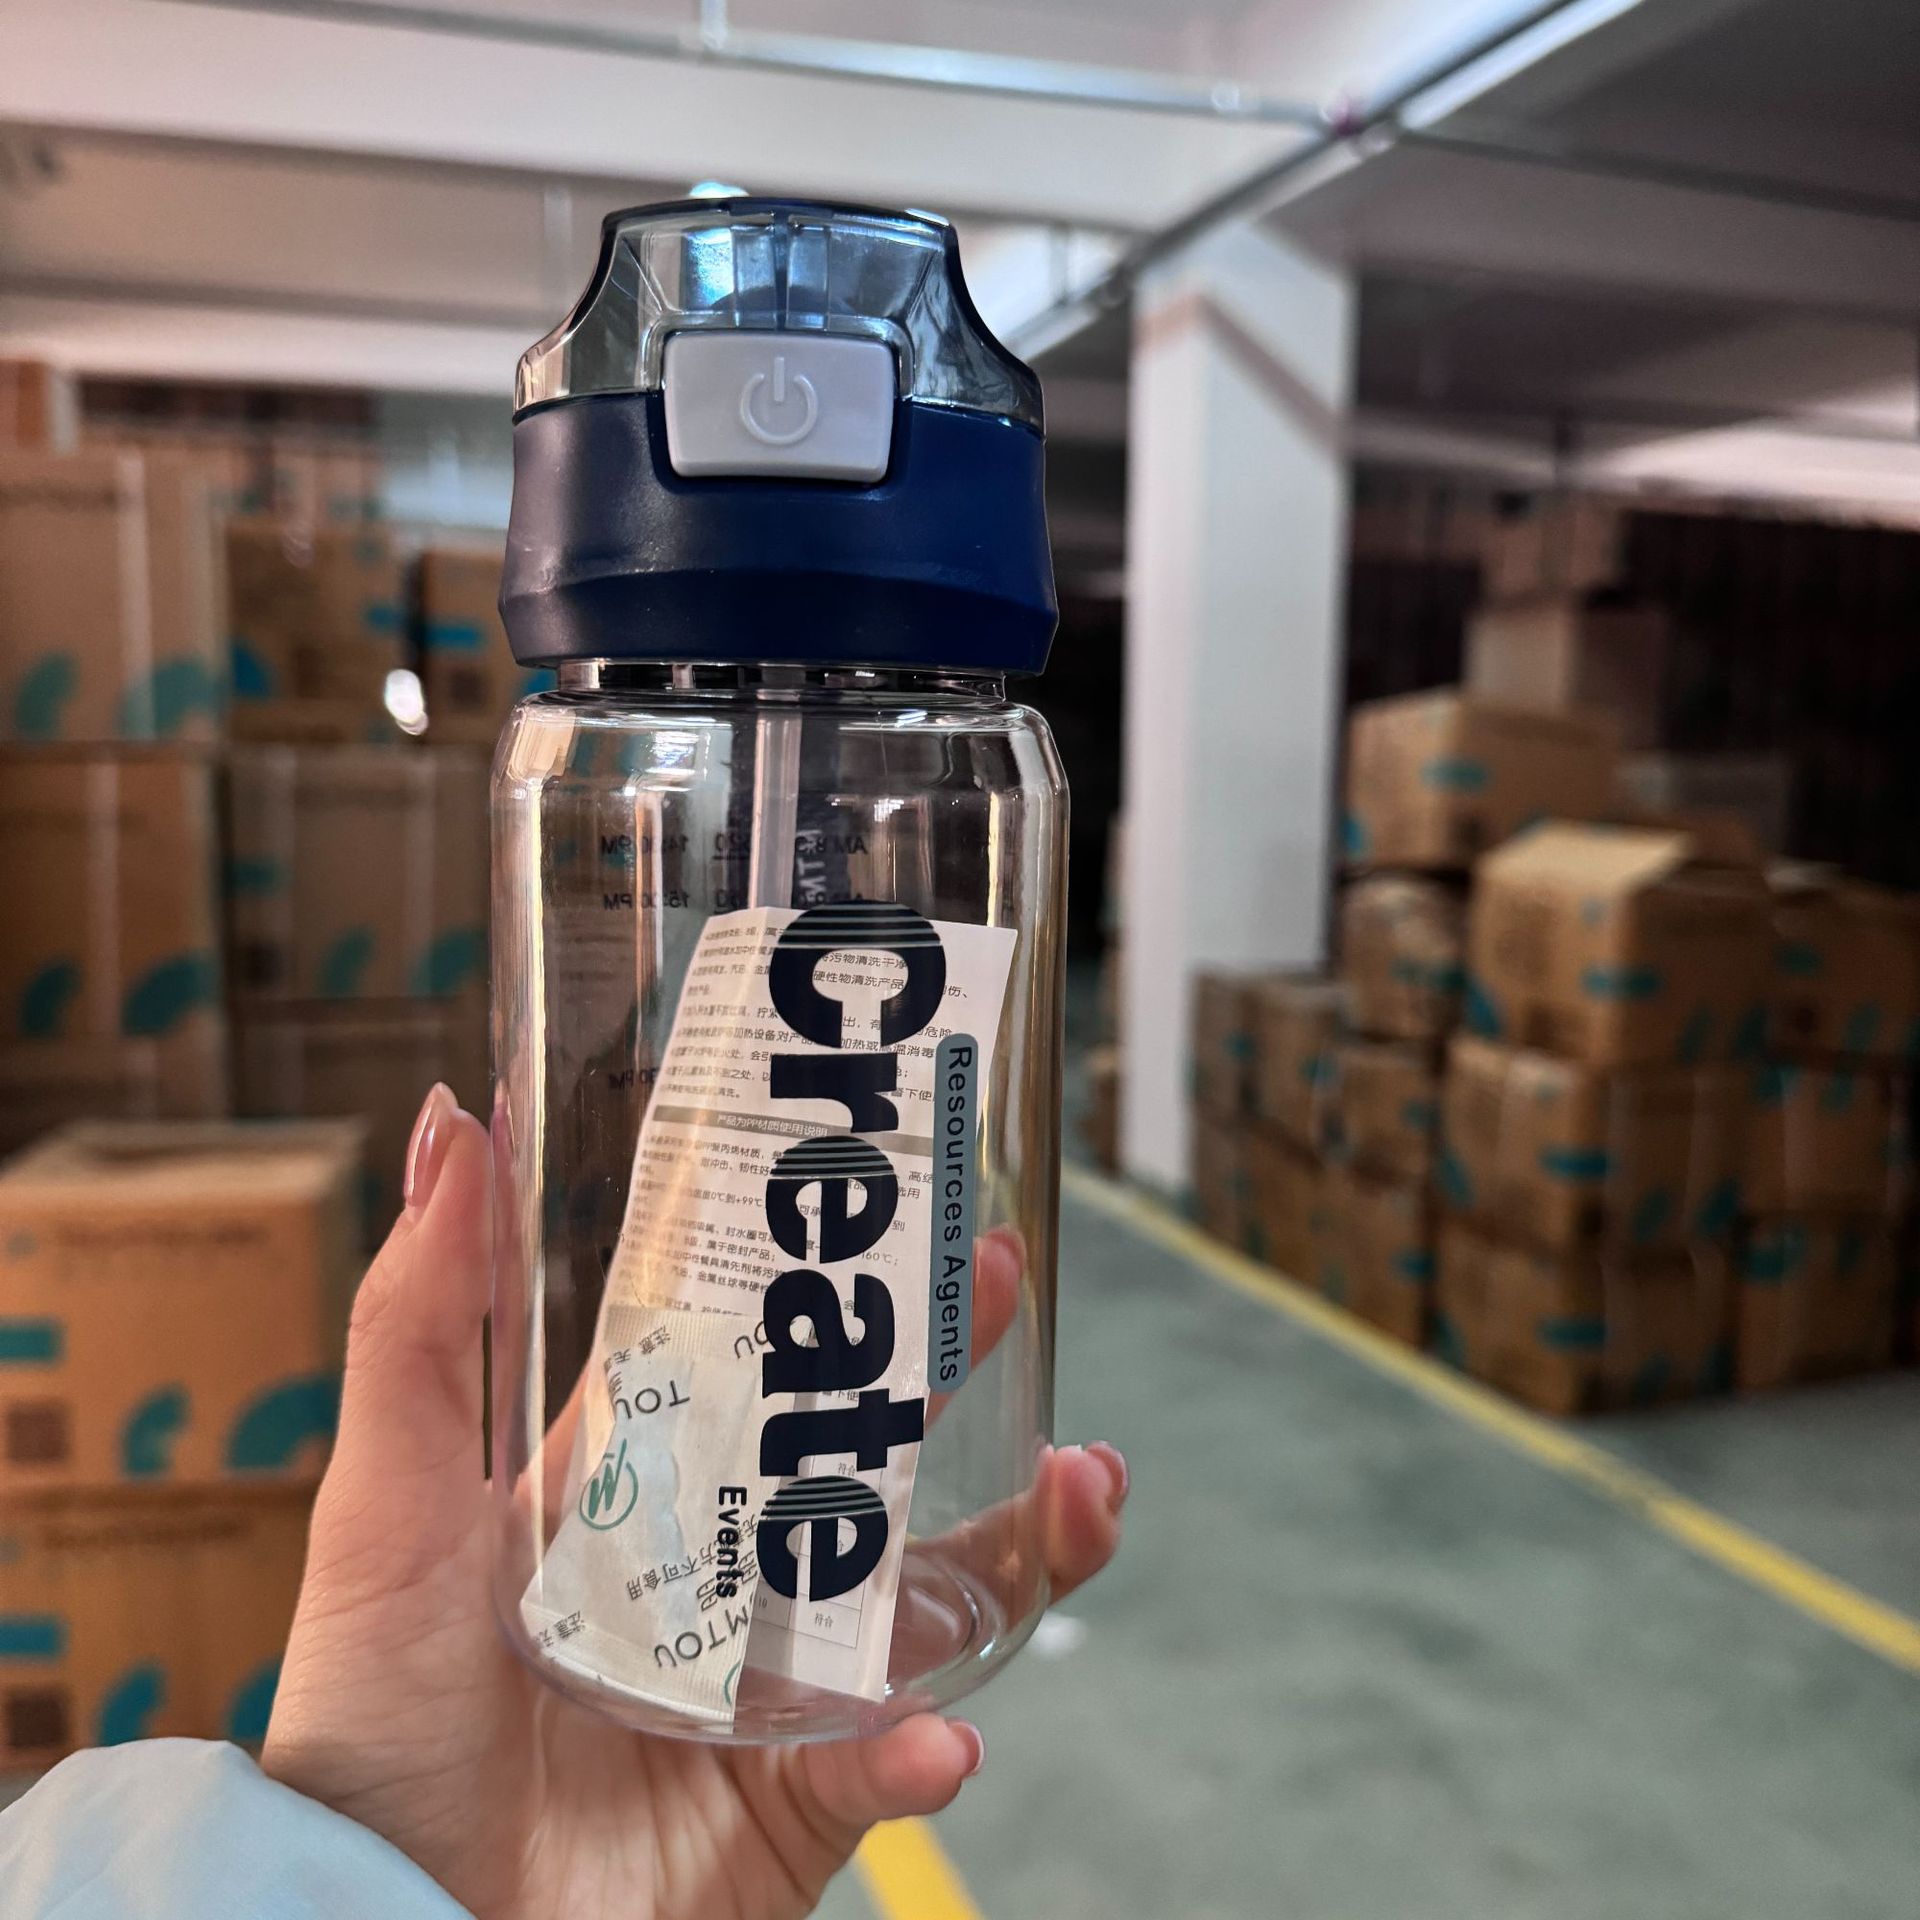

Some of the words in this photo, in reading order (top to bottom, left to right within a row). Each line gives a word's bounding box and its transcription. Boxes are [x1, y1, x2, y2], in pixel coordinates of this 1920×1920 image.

[943, 1046, 973, 1242] Resources
[757, 900, 947, 1602] Create
[936, 1253, 967, 1382] Agents
[715, 1485, 748, 1599] Events
[654, 1592, 754, 1669] MTOU
